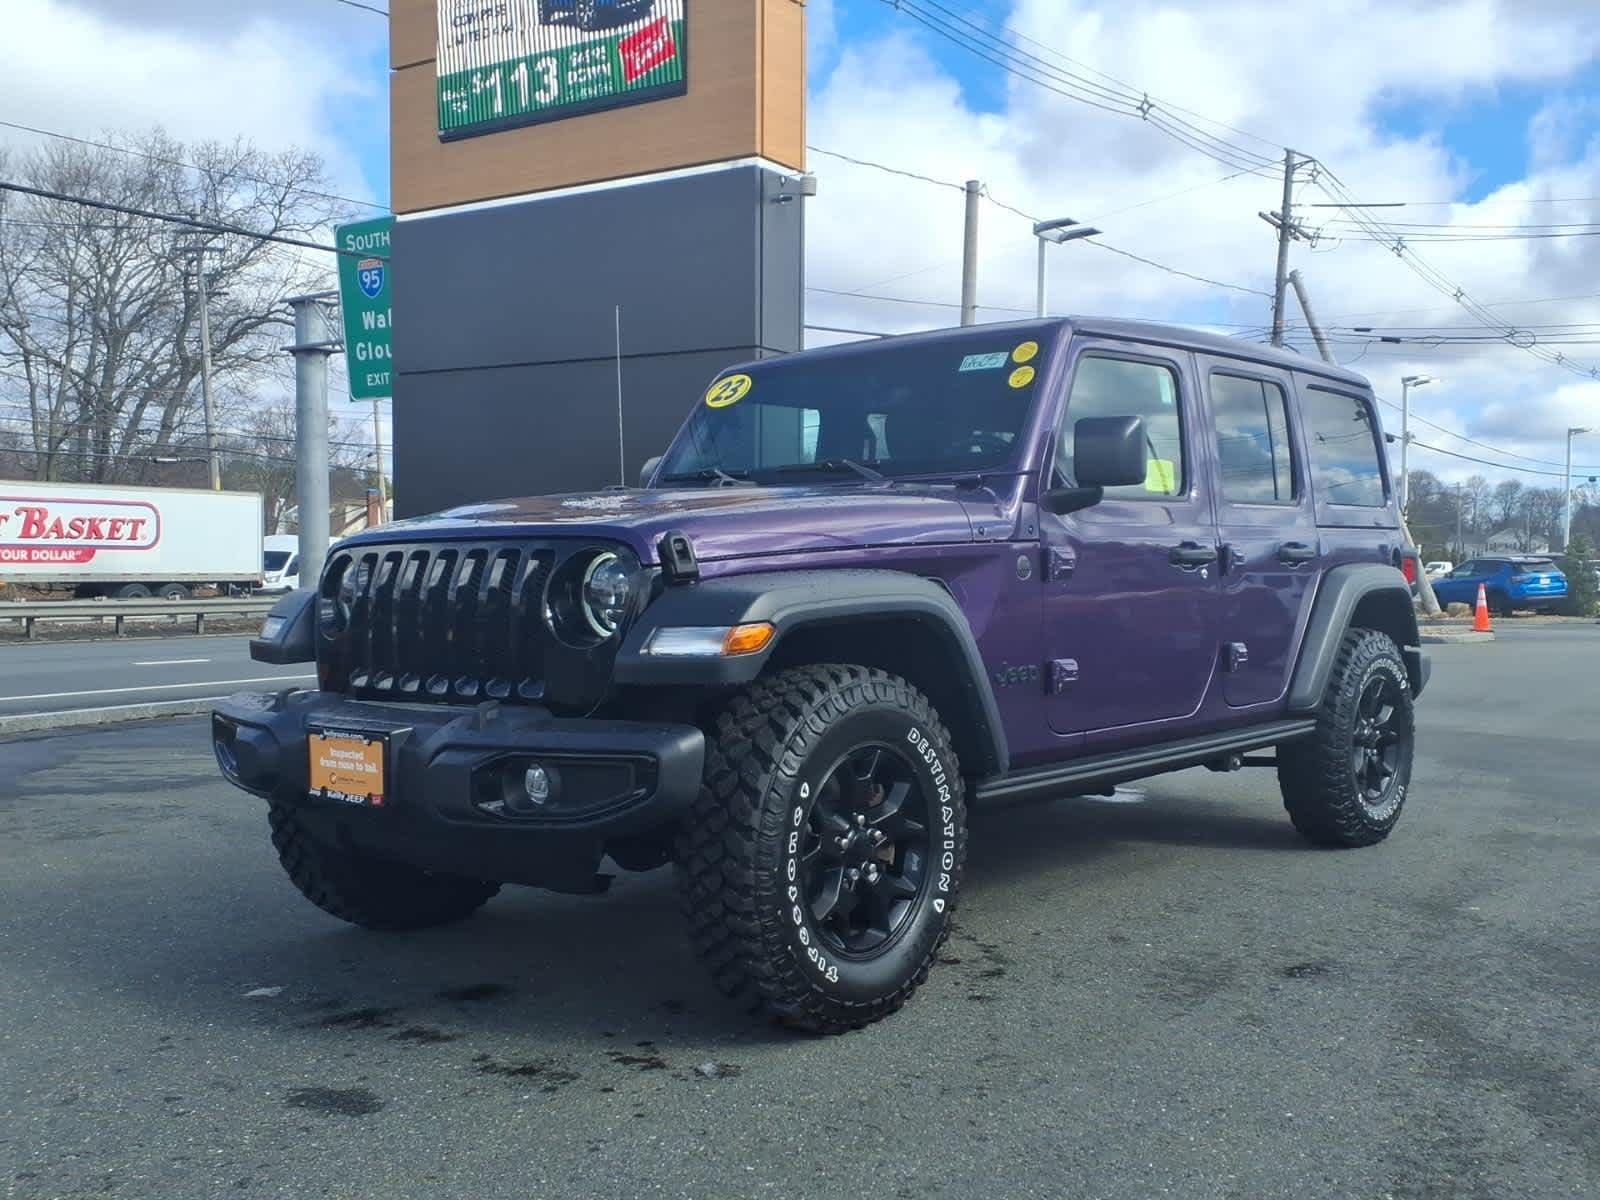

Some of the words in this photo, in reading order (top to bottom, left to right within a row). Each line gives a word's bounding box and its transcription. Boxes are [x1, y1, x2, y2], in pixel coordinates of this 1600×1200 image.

[361, 270, 380, 289] 95
[366, 372, 390, 387] EXIT
[710, 377, 746, 402] 23
[15, 506, 147, 541] BASKET
[345, 794, 364, 804] JEEP
[906, 727, 956, 892] DESTINATION
